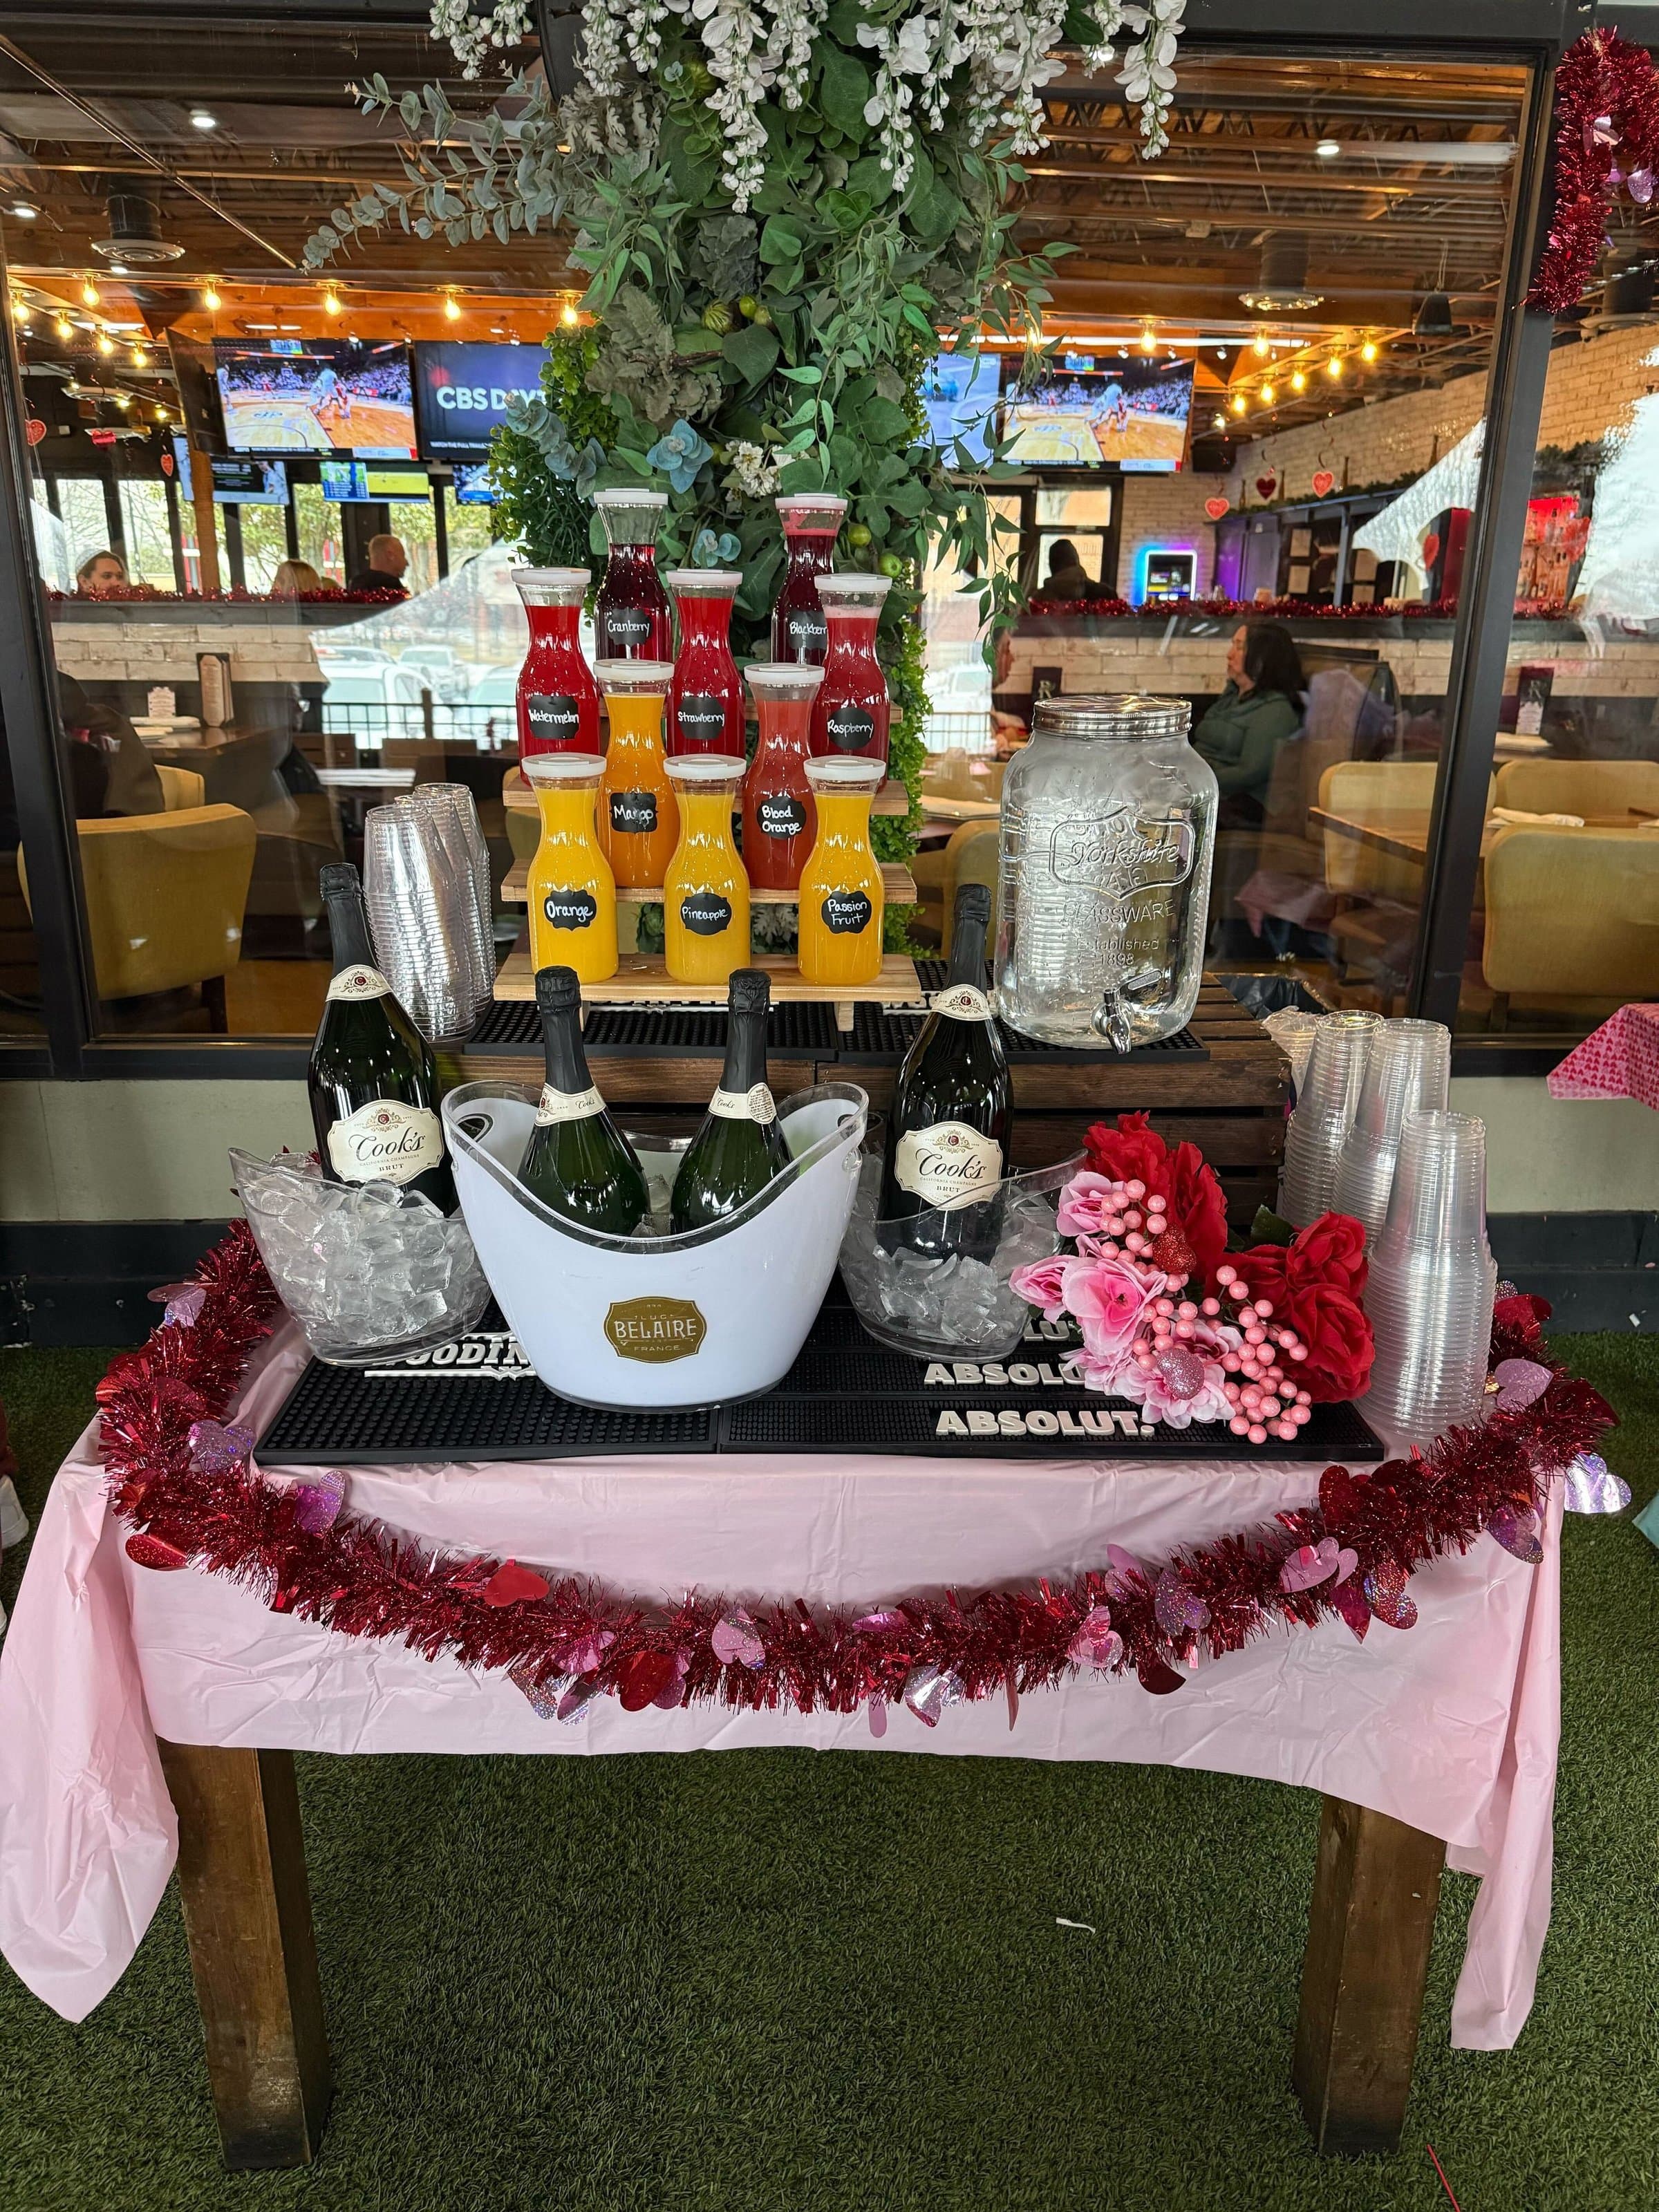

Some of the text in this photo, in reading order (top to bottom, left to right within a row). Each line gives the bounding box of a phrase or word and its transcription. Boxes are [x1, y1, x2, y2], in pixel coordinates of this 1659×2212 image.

[436, 386, 488, 410] CBS
[608, 619, 650, 637] Cranberry
[528, 709, 579, 724] Watermelon
[677, 711, 724, 727] Strawberry
[827, 719, 874, 739] Raspberry
[762, 805, 794, 818] Blood
[762, 821, 802, 835] Orange
[546, 901, 593, 922] Orange
[827, 899, 868, 912] Passion
[682, 906, 729, 921] Pineapple
[831, 912, 863, 926] Fruit
[1076, 937, 1159, 951] Established
[1100, 953, 1134, 966] 1898
[575, 1096, 595, 1109] Cook's
[348, 1127, 426, 1161] Cook's
[379, 1163, 404, 1172] BRUT
[915, 1148, 986, 1179] Cook's
[614, 1318, 697, 1339] BELAIRE
